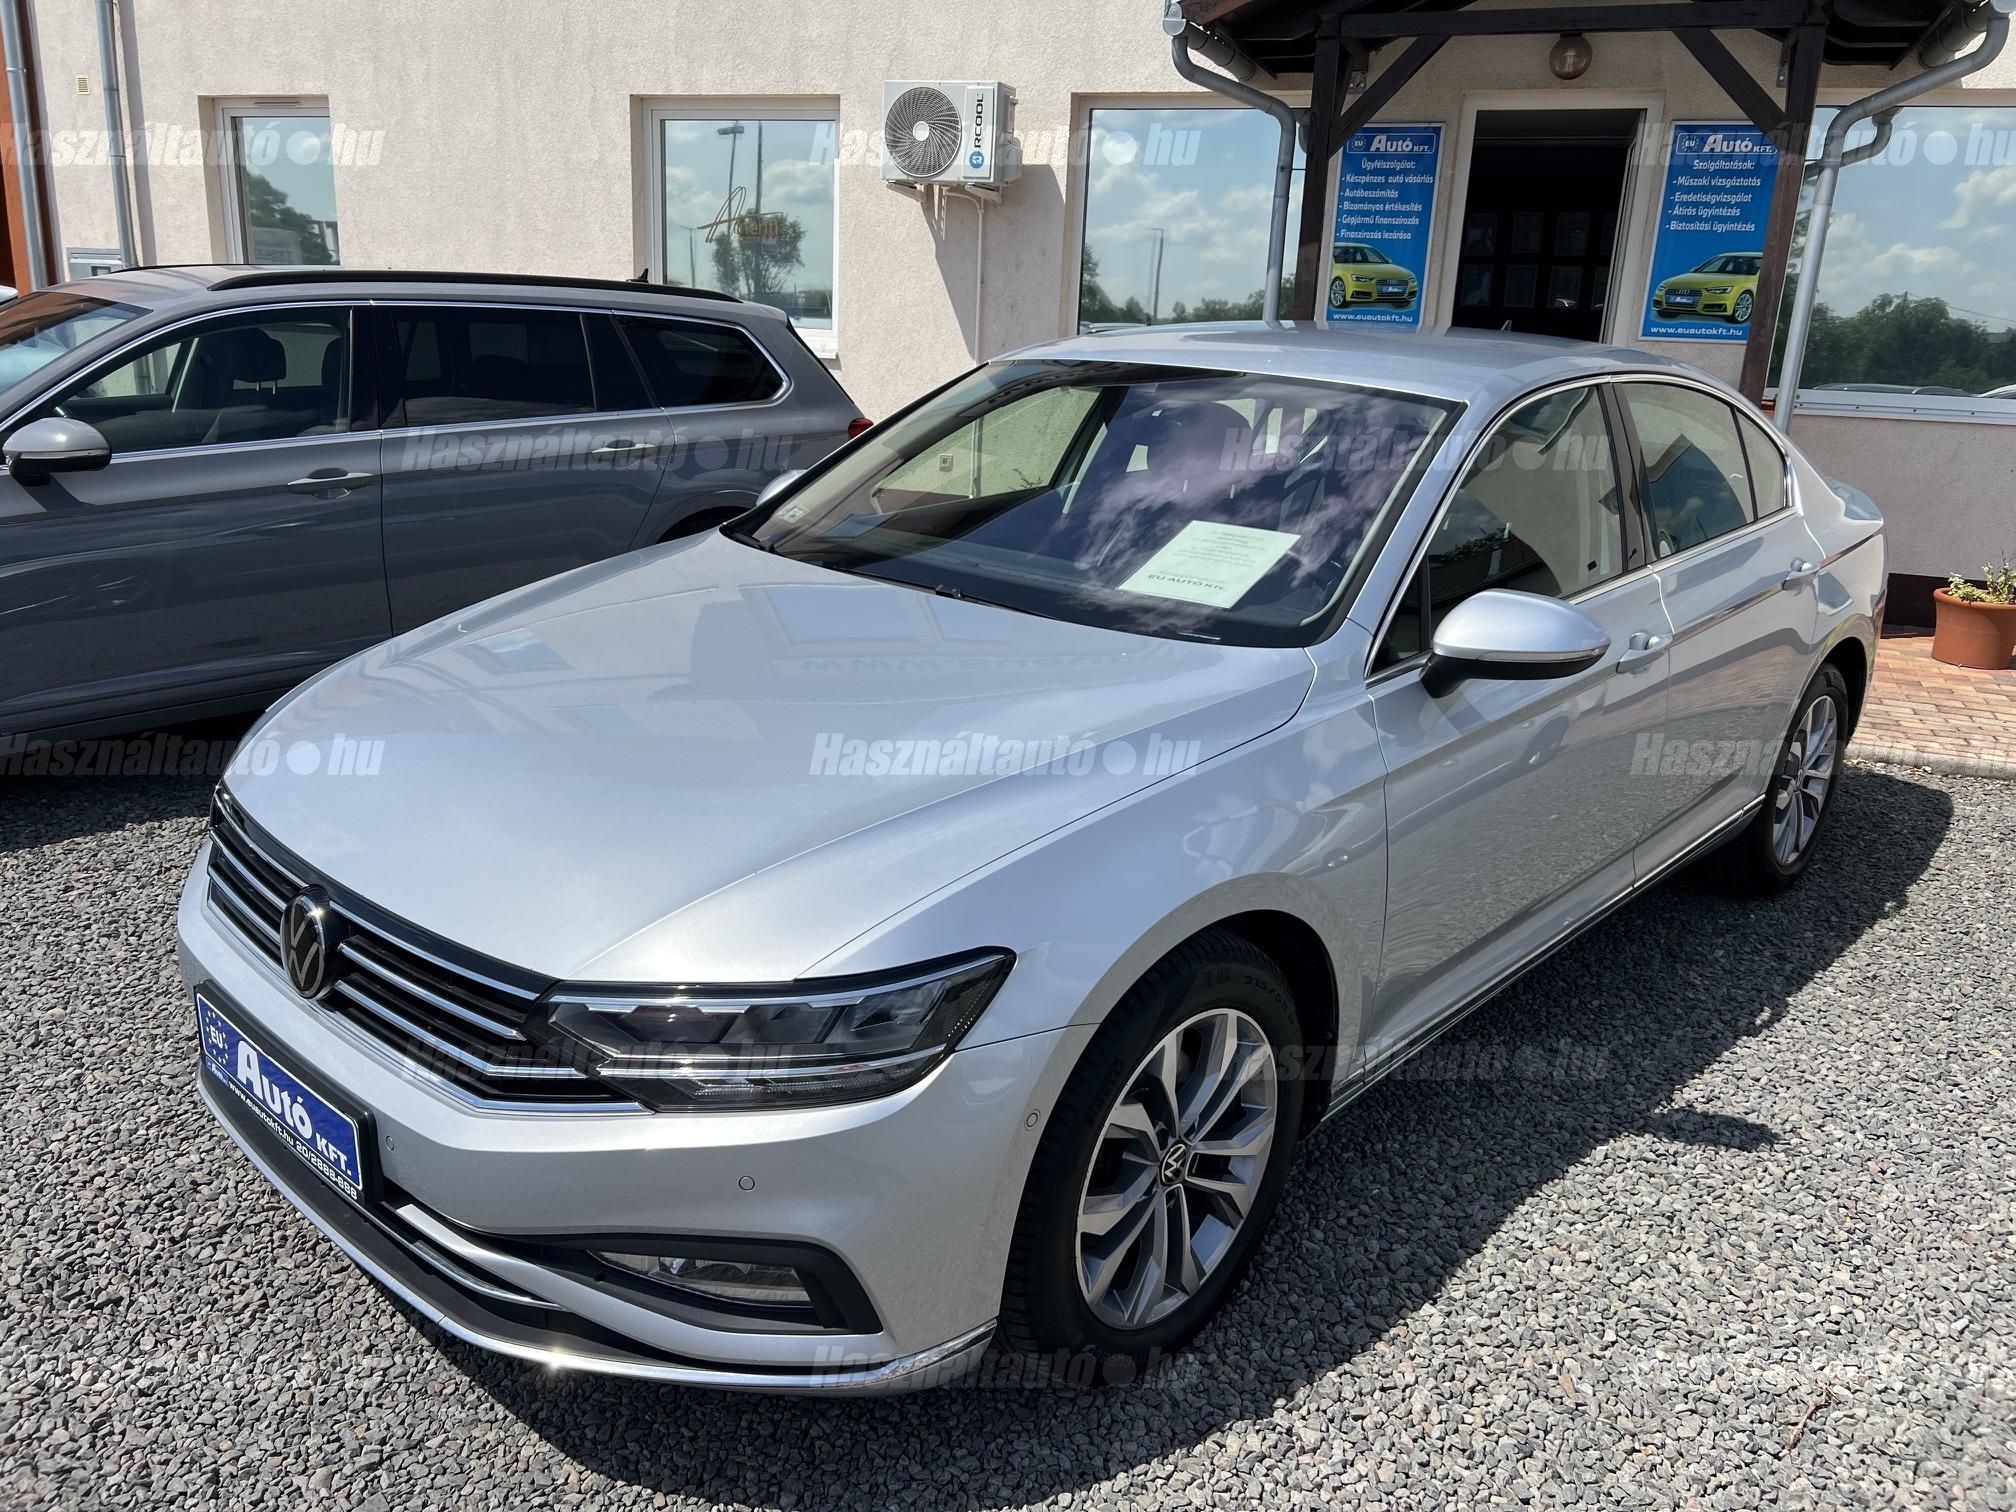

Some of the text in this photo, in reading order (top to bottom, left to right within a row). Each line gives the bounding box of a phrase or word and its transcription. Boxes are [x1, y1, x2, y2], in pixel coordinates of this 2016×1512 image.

[1369, 134, 1414, 152] Autó
[1703, 134, 1753, 153] Autó
[1361, 159, 1416, 170] Ügyfélszolgálat:
[1693, 159, 1755, 171] Szolgáltatások:
[1388, 174, 1404, 183] autó
[1405, 174, 1434, 184] vásárlás
[1711, 176, 1761, 188] vizsgáztatás
[1698, 206, 1741, 217] ügyintézés
[1712, 221, 1755, 233] ügyintézés
[1333, 313, 1413, 322] www.euautokft.hu
[1650, 325, 1743, 336] www.euautokft.hu
[210, 1024, 223, 1050] EU
[237, 1040, 313, 1140] Autó
[315, 1132, 352, 1176] KFT.
[228, 1081, 294, 1147] www.euautokft.hu
